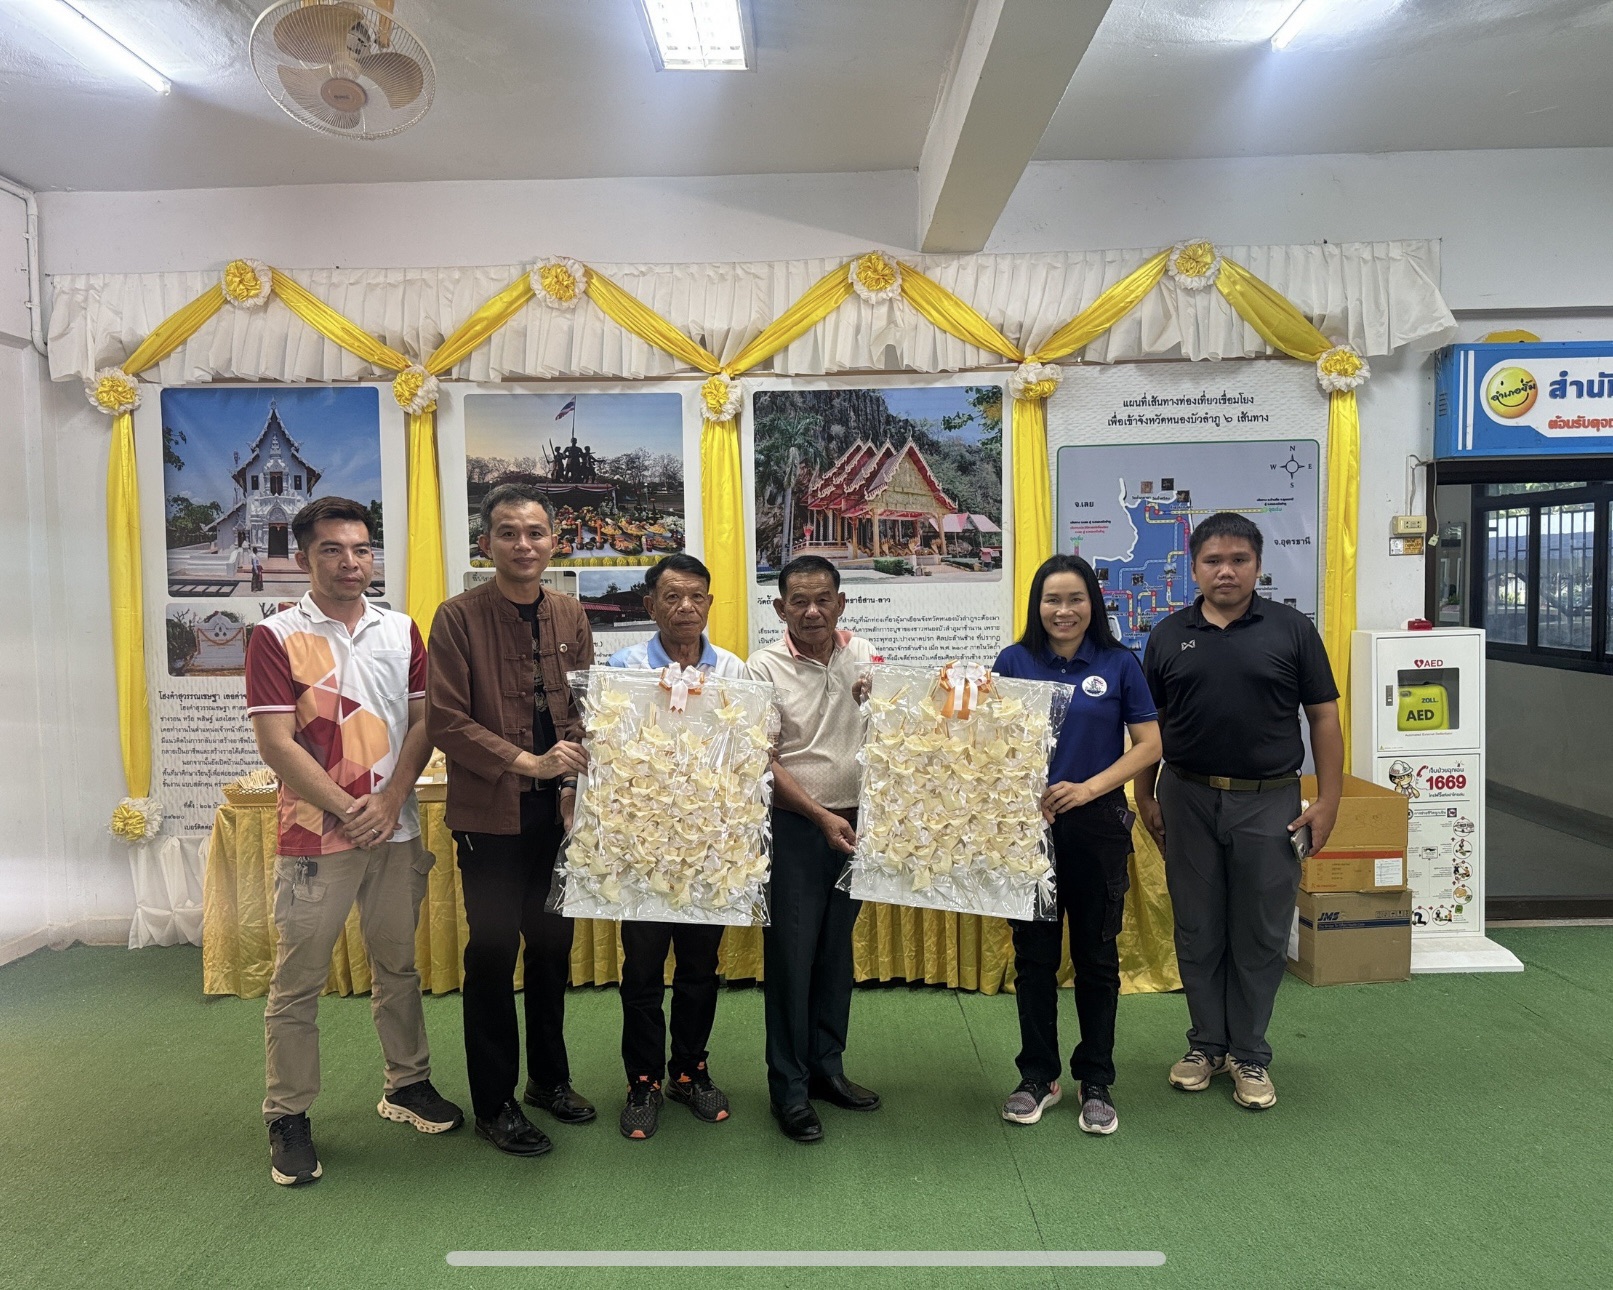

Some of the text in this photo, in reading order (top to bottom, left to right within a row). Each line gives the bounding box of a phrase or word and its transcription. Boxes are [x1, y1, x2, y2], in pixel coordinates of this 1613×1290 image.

[1491, 379, 1536, 401] อำเภอยิ้ม
[1123, 390, 1254, 408] แผนที่เส้นทางท่องเที่ยวเชื่อมโยง
[1107, 411, 1220, 428] เพื่อเข้าจังหวัดหนองบัวลำภู
[1237, 410, 1269, 423] เส้นทาง
[1289, 481, 1295, 489] S
[1273, 537, 1311, 548] จ.อุดรธานี
[1424, 659, 1443, 668] AED
[1406, 709, 1435, 722] AED
[1425, 774, 1467, 791] 1669
[1317, 911, 1340, 922] JMS
